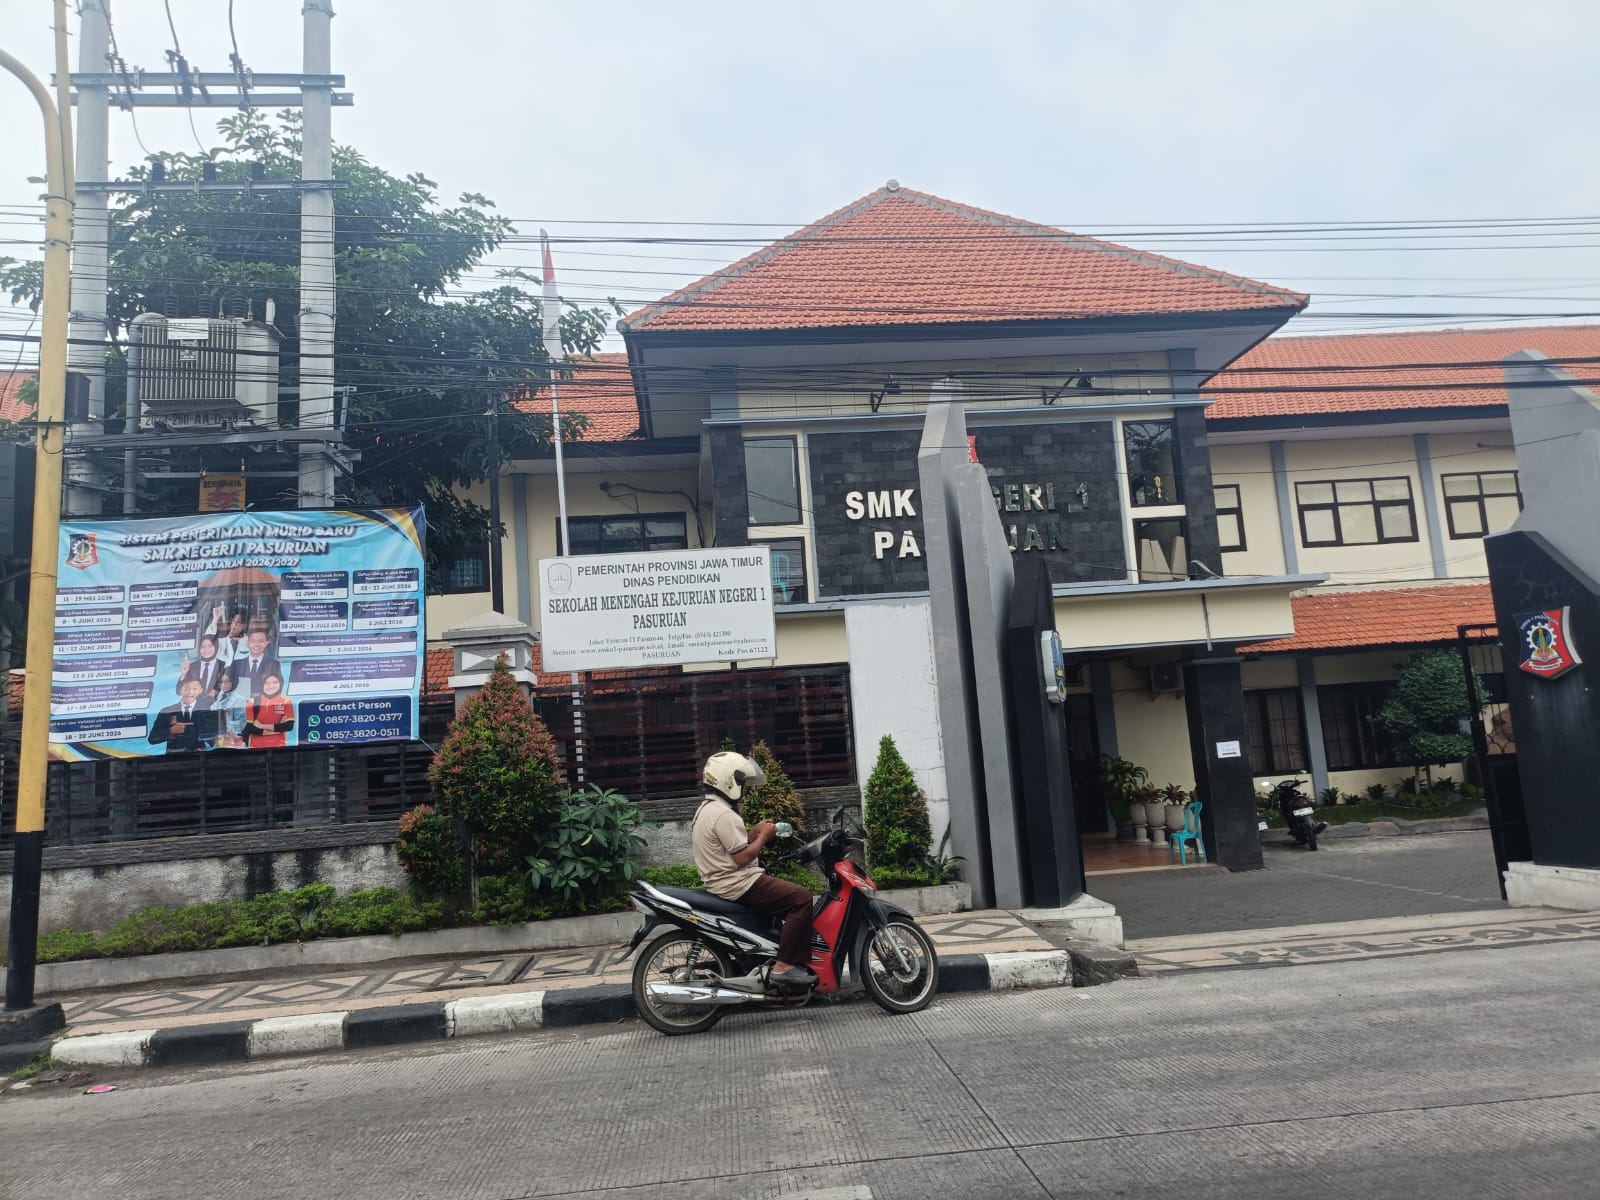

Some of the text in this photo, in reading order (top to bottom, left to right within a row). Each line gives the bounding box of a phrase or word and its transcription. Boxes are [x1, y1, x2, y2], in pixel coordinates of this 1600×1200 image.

[846, 489, 916, 520] SMK
[119, 524, 356, 547] SISTEM PENERIMAAN MURID BARU
[142, 548, 178, 563] SMK
[178, 543, 236, 561] NEGERI
[245, 540, 330, 556] PASURUAN
[171, 557, 301, 573] TAHUN AJARAN 2026/2027
[577, 556, 764, 577] PEMERINTAH PROVINSI JAWA TIMUR
[623, 573, 721, 588] DINAS PENDIDIKAN
[548, 587, 766, 614] SEKOLAH MENENGAH KEJURUAN NEGERI 1
[632, 612, 687, 629] PASURUAN
[642, 651, 681, 660] PASURUAN
[718, 648, 735, 656] Kode
[318, 700, 392, 712] Contact Person
[324, 713, 403, 724] 0857-3820-0377
[326, 728, 400, 739] 0857-3820-0511
